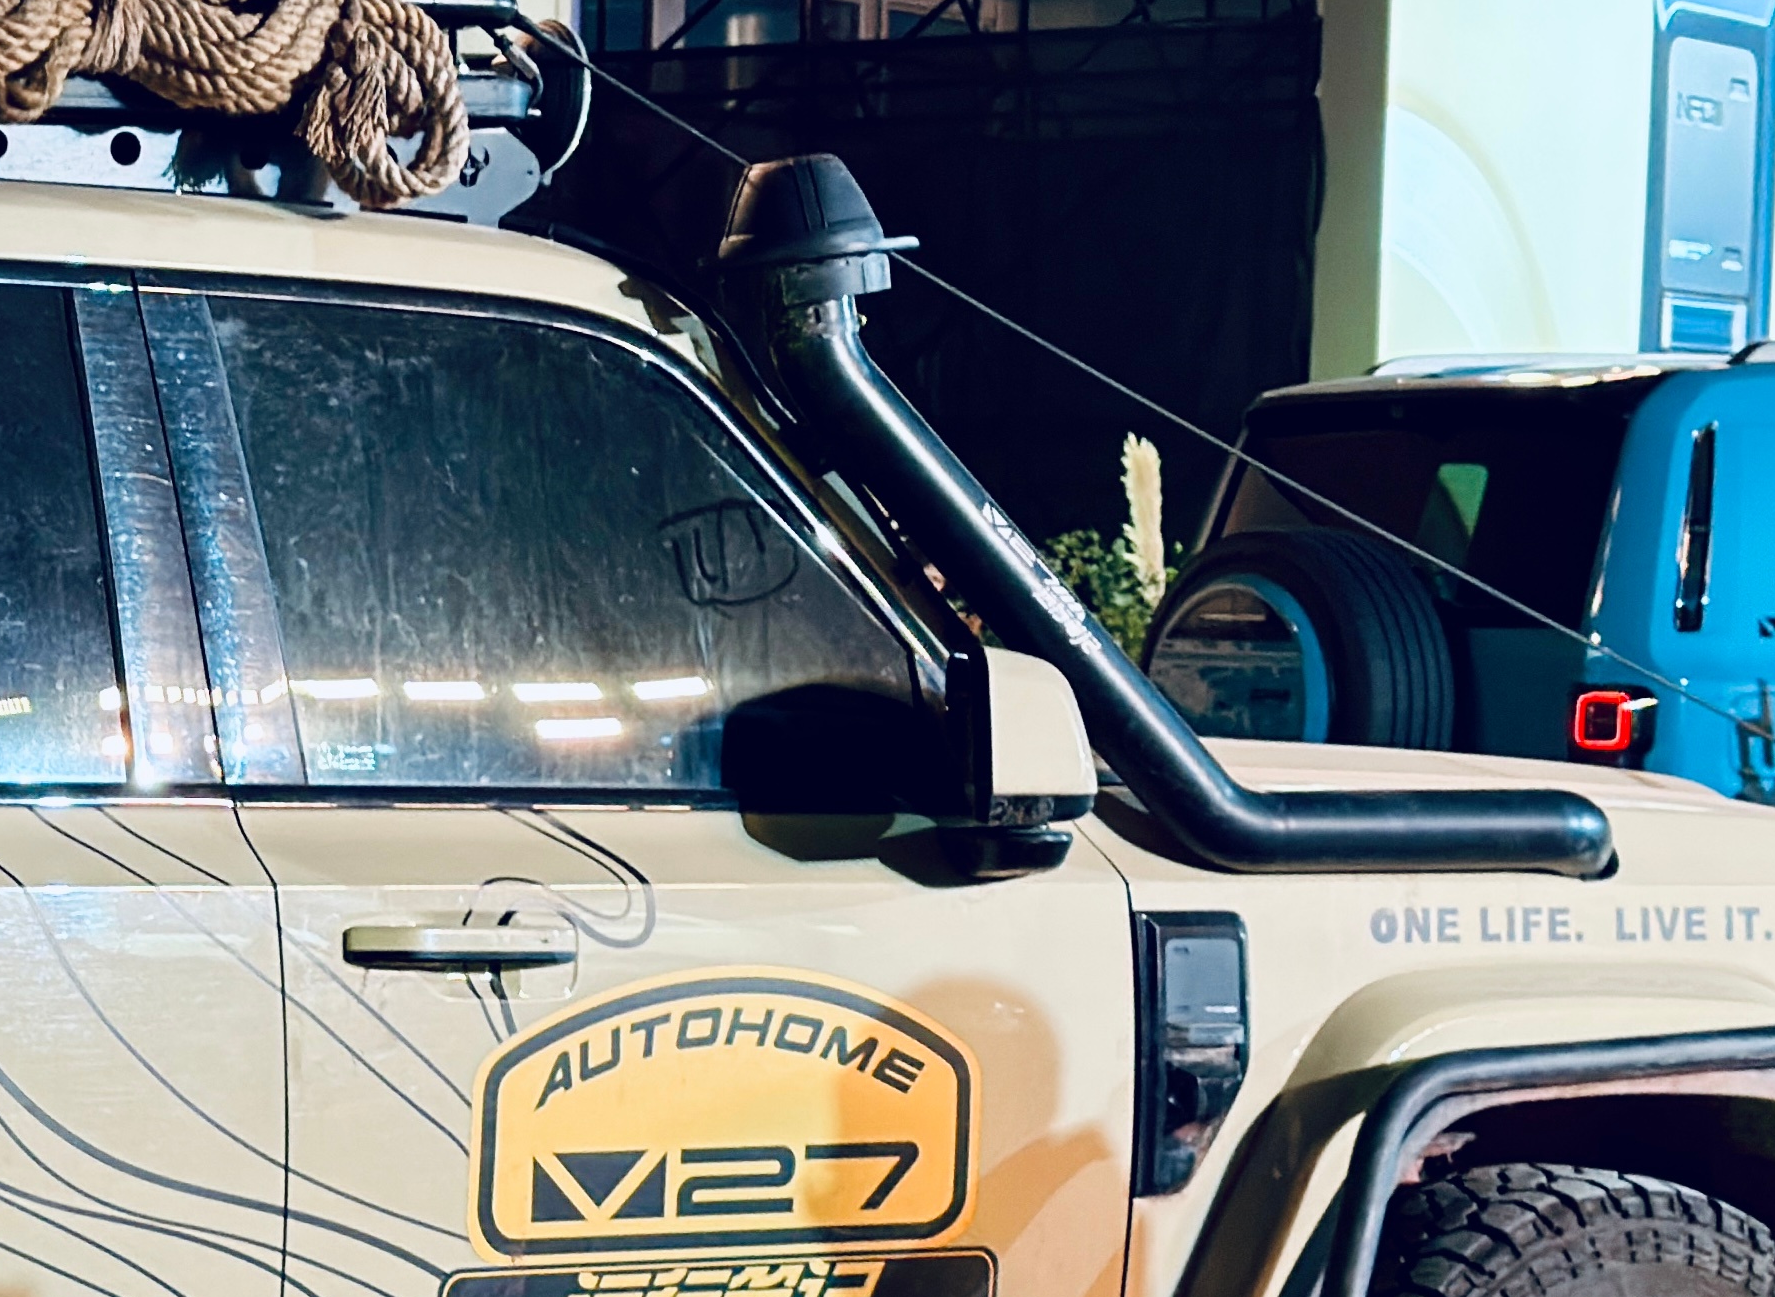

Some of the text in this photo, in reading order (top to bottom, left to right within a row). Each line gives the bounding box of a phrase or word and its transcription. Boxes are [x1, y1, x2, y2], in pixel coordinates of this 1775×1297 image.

[1370, 906, 1774, 944] ONE LIFE. LIVE IT.
[535, 1008, 925, 1111] AUTOHOME
